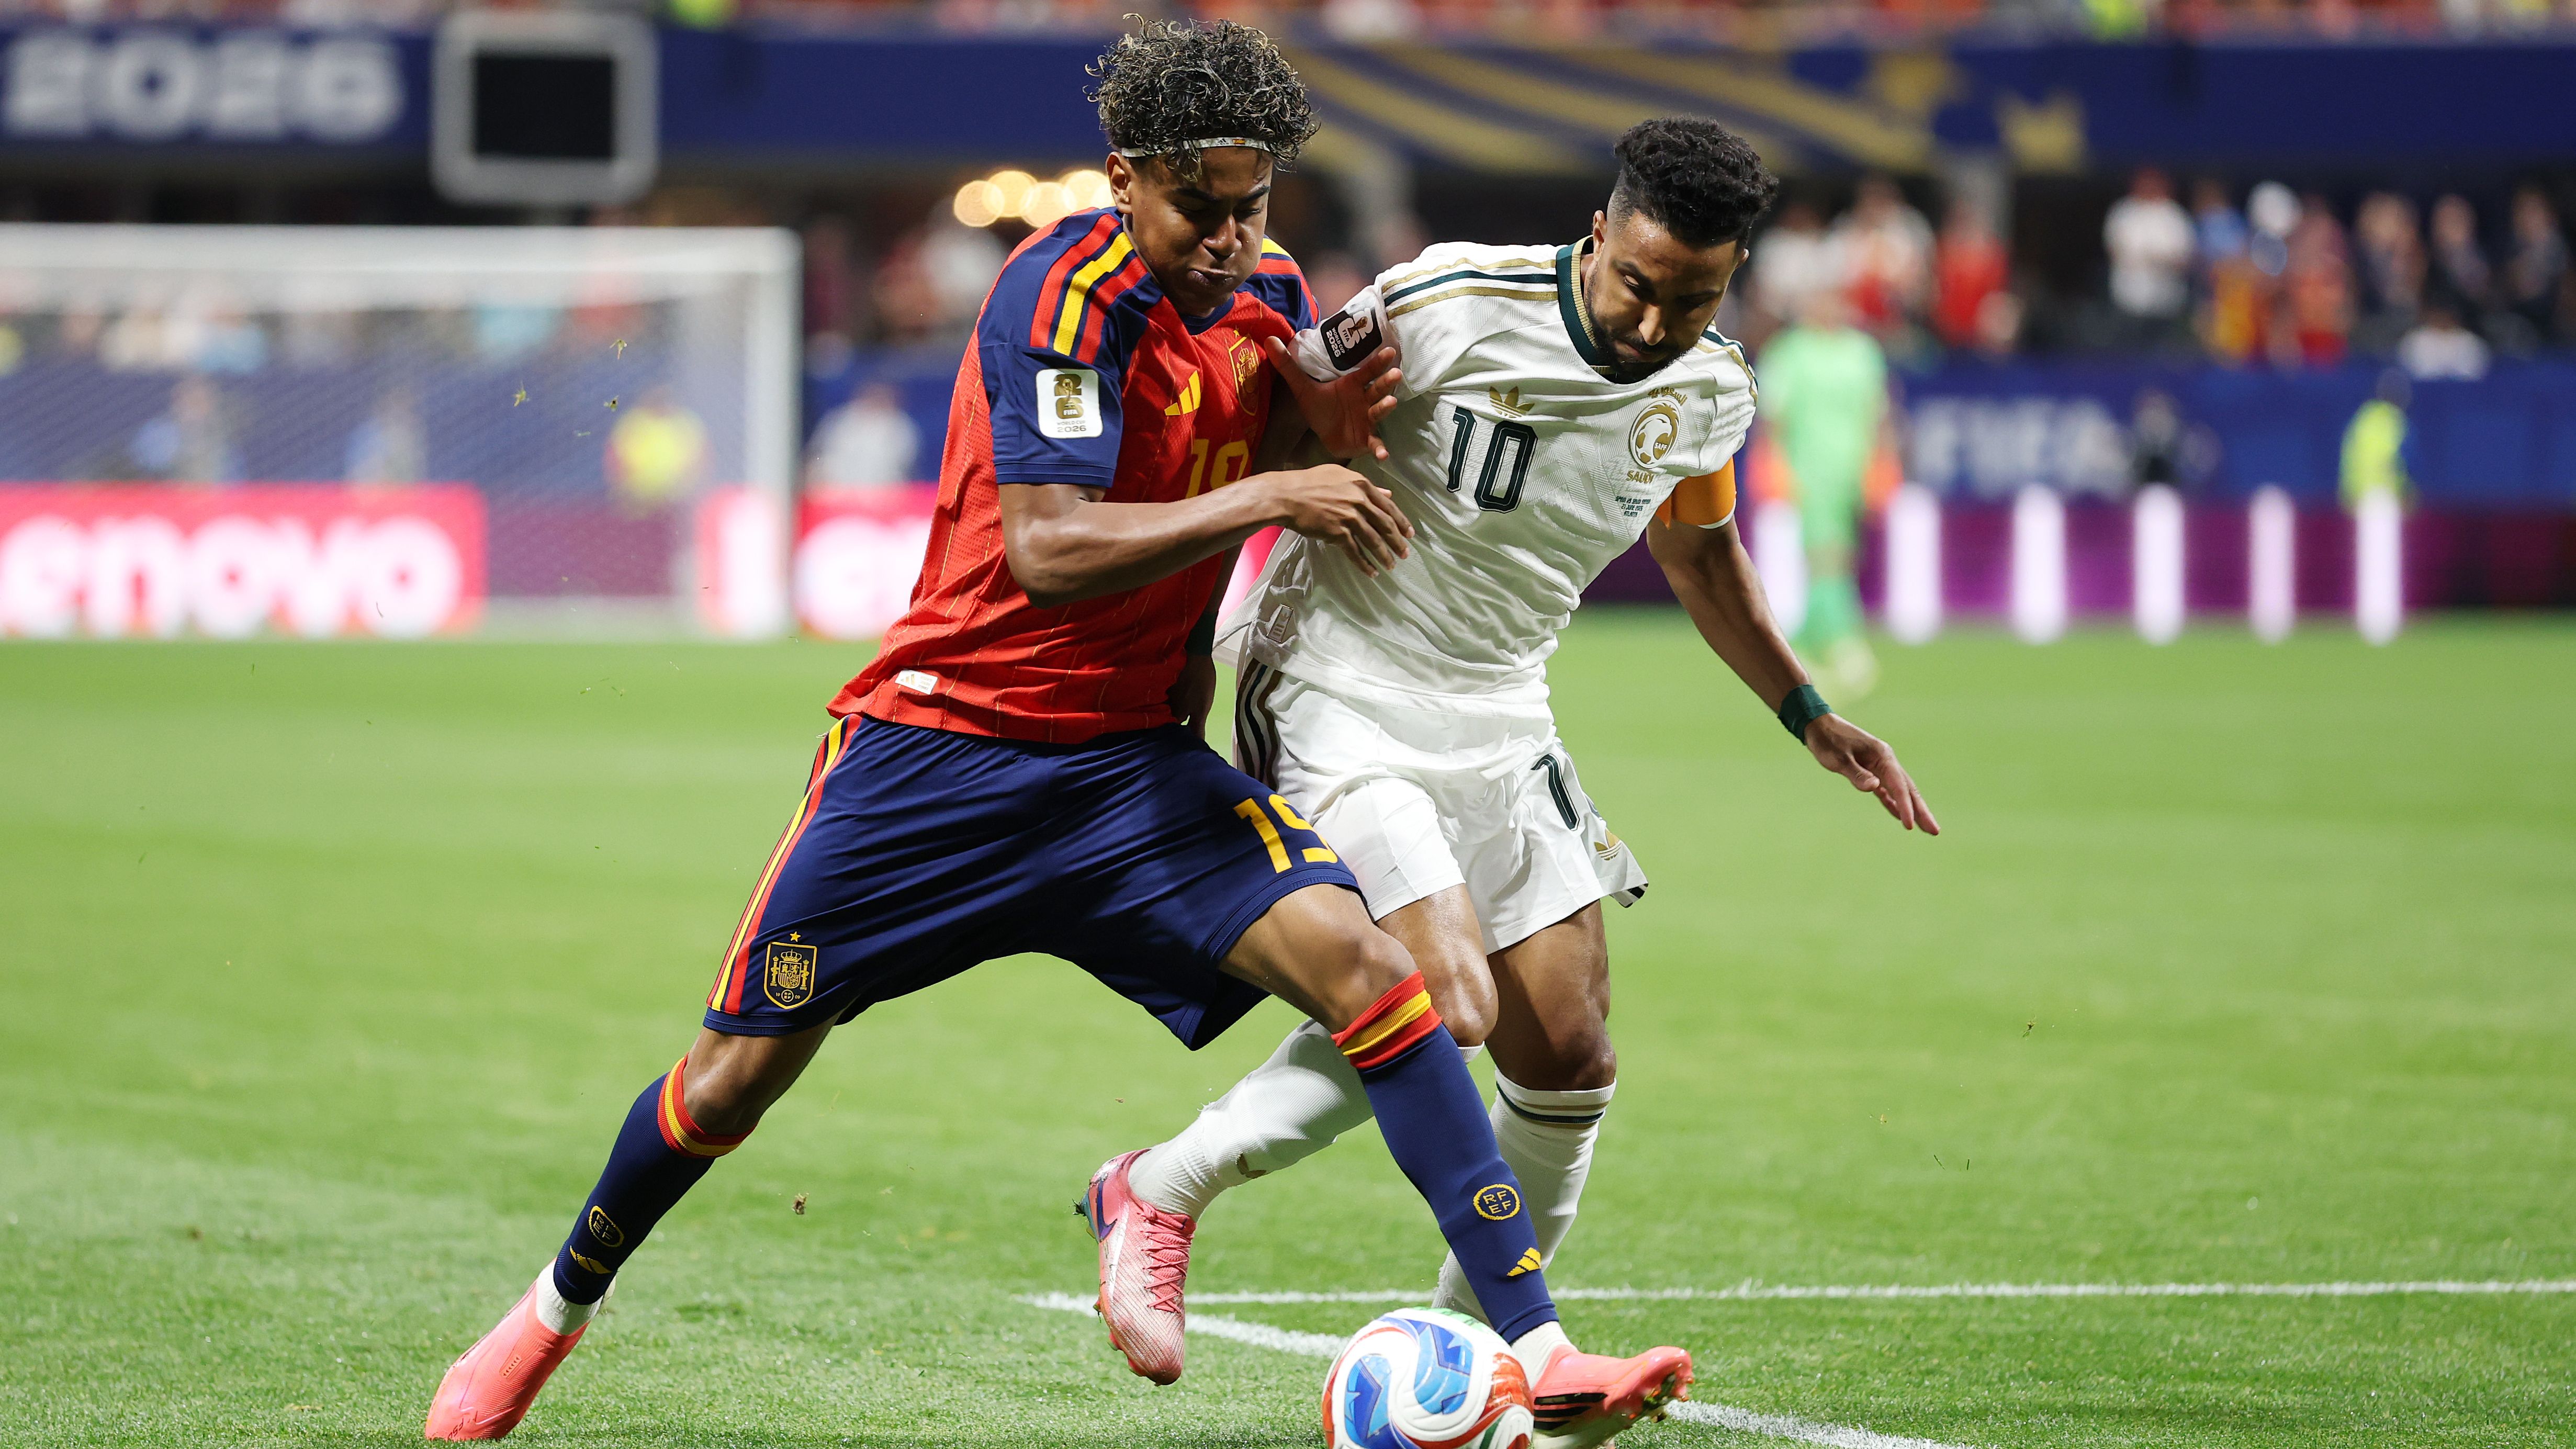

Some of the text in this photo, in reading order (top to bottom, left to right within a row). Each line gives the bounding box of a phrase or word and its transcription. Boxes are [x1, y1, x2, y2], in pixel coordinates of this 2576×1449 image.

[6, 30, 402, 140] 2026
[1326, 330, 1341, 357] 2026
[1332, 327, 1341, 344] WORLD
[1654, 442, 1668, 451] SAFF
[1913, 395, 2138, 495] FIFA
[1447, 406, 1538, 513] 10
[1626, 470, 1655, 484] SAUDI
[1531, 753, 1601, 831] 1
[1233, 793, 1341, 874] 19
[1483, 1190, 1507, 1204] RF
[1489, 1200, 1511, 1214] EF
